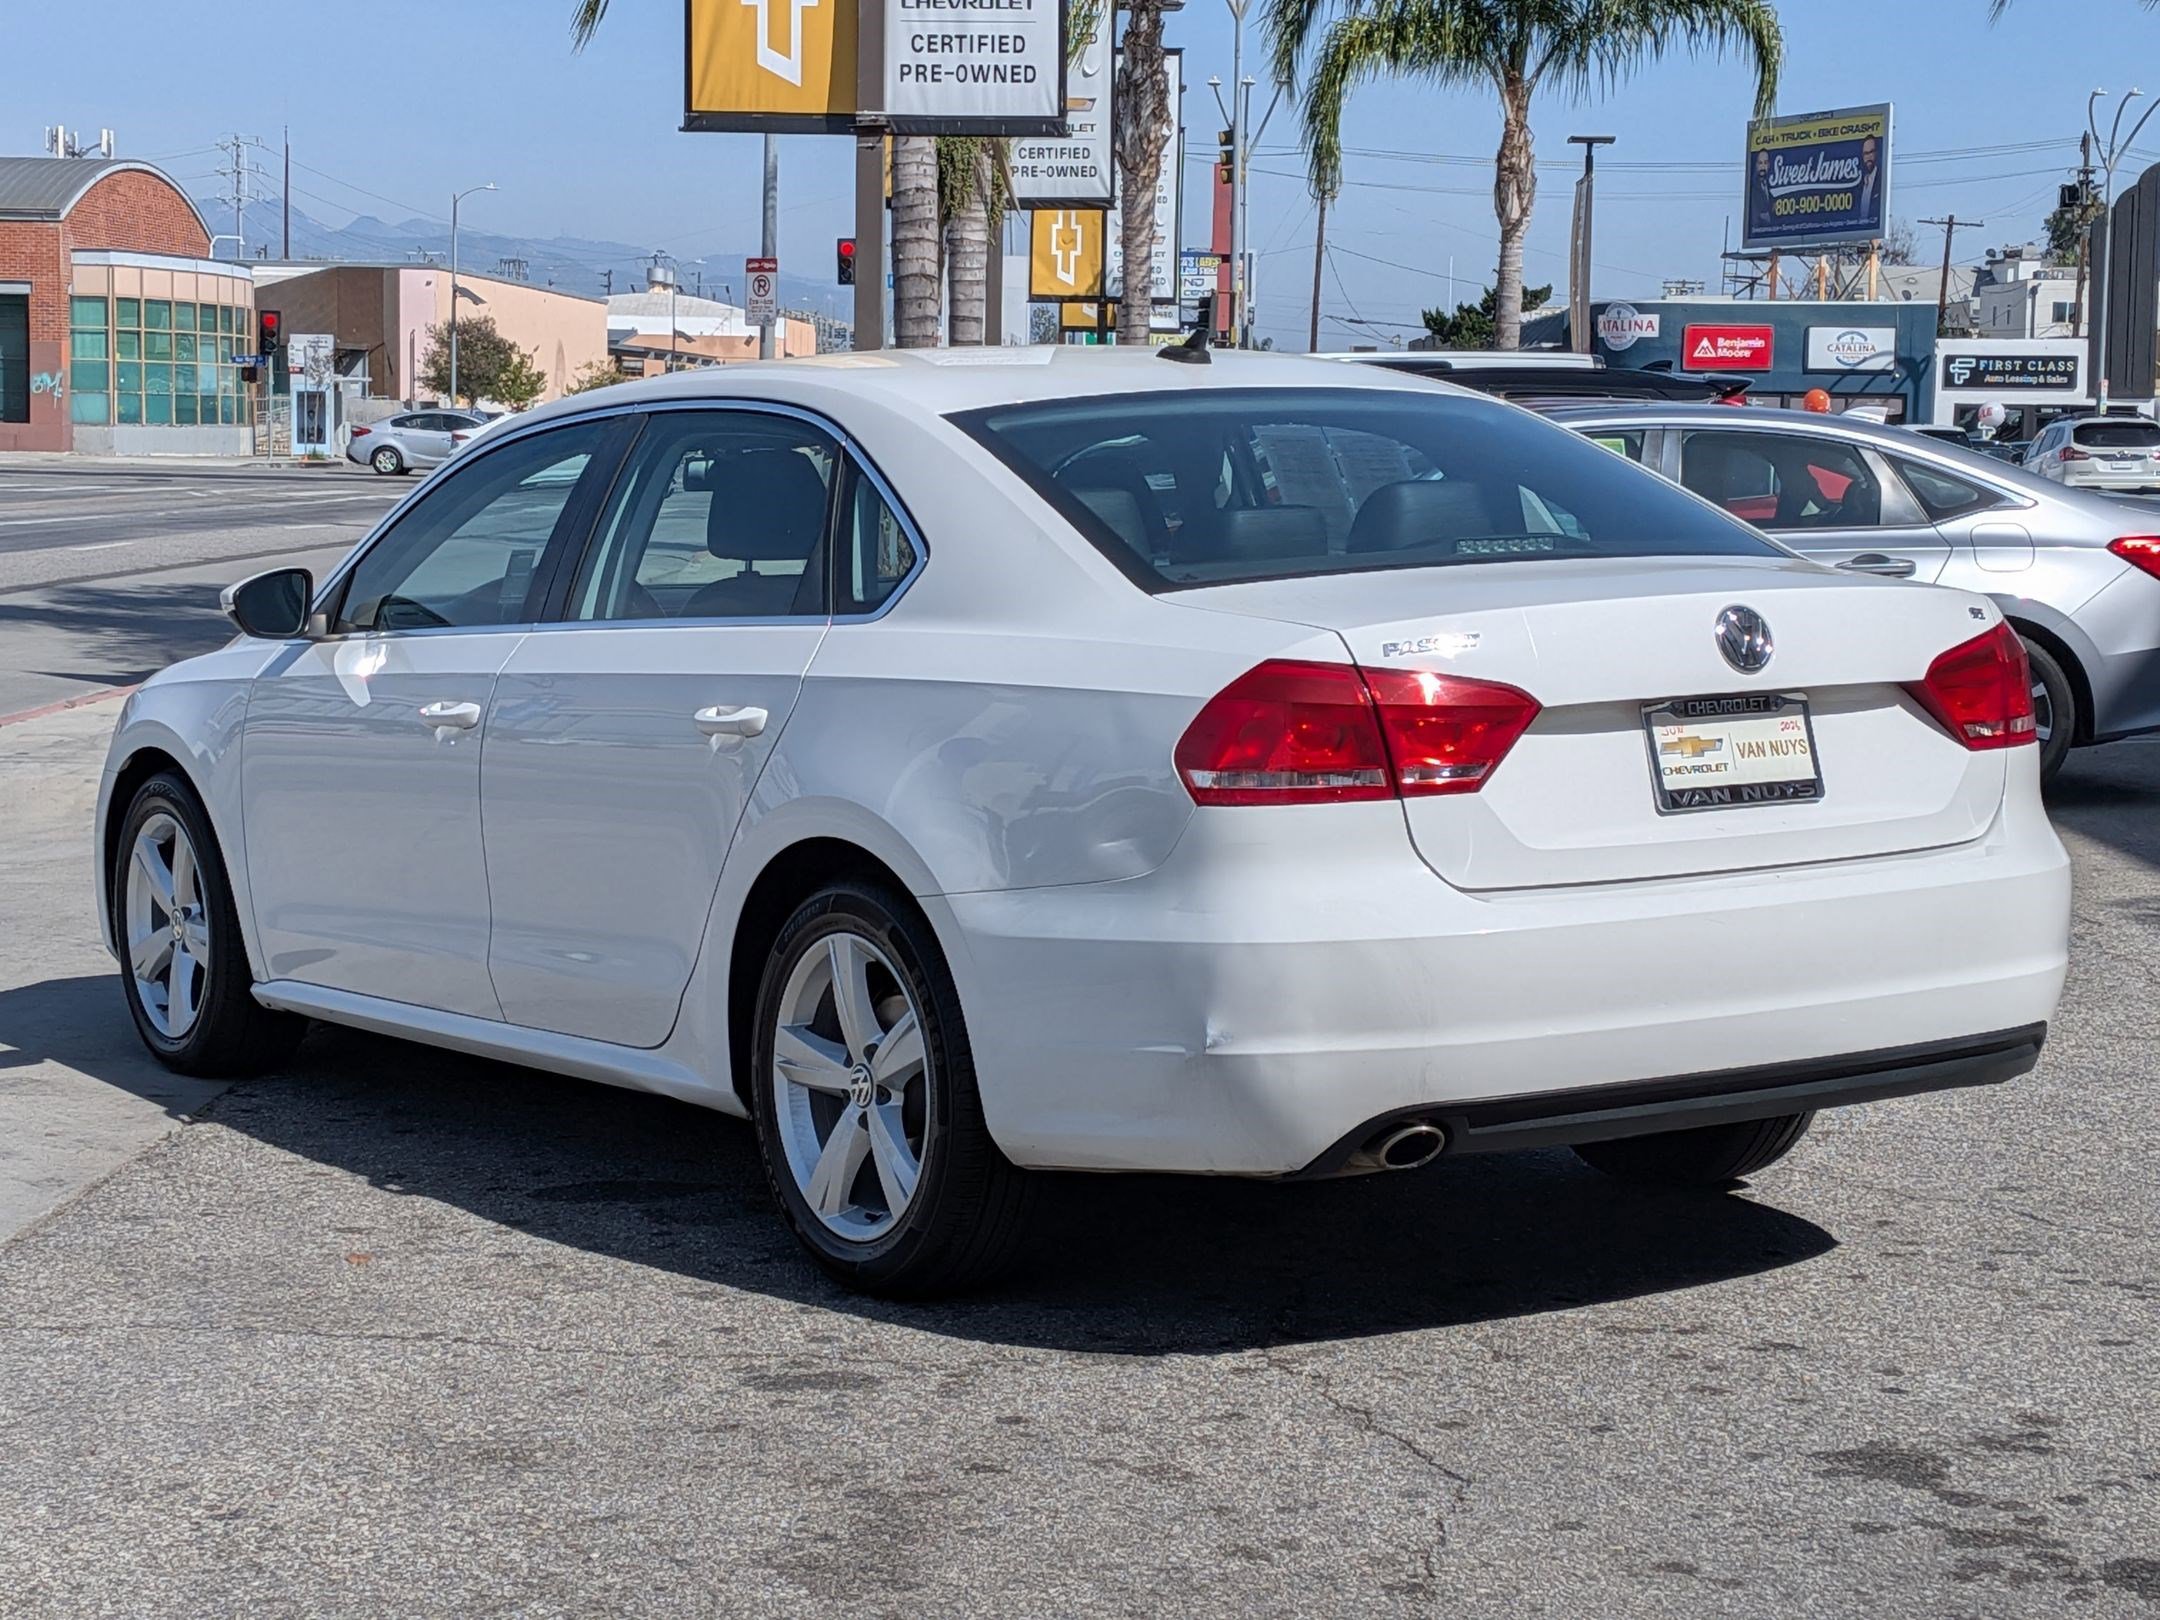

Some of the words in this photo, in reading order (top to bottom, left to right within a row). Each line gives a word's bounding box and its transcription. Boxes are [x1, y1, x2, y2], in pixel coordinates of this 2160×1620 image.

[911, 34, 1026, 54] CERTIFIED
[899, 64, 1037, 84] PRE-OWNED
[1781, 130, 1812, 142] TRUCK
[1818, 127, 1839, 138] BIKE
[1840, 122, 1880, 135] CRASH?
[1018, 147, 1091, 159] CERTIFIED
[1011, 165, 1098, 178] PRE-OWNED
[1775, 193, 1853, 216] 800-900-0000
[1717, 336, 1765, 350] Benjamin
[1827, 343, 1876, 352] CATALINA
[1717, 348, 1752, 358] Moore
[1979, 360, 2022, 371] FIRST
[2027, 361, 2074, 372] CLASS
[1984, 374, 2004, 383] Auto
[2005, 374, 2038, 385] Leasing
[2046, 374, 2068, 384] Sales
[1382, 633, 1480, 658] PAST
[1688, 697, 1766, 715] CHEVROLET
[1736, 741, 1767, 759] VAN
[1768, 739, 1808, 757] NUYS
[1662, 762, 1729, 776] CHEVROLET
[1671, 788, 1732, 806] VAN
[1742, 783, 1817, 800] NUYS
